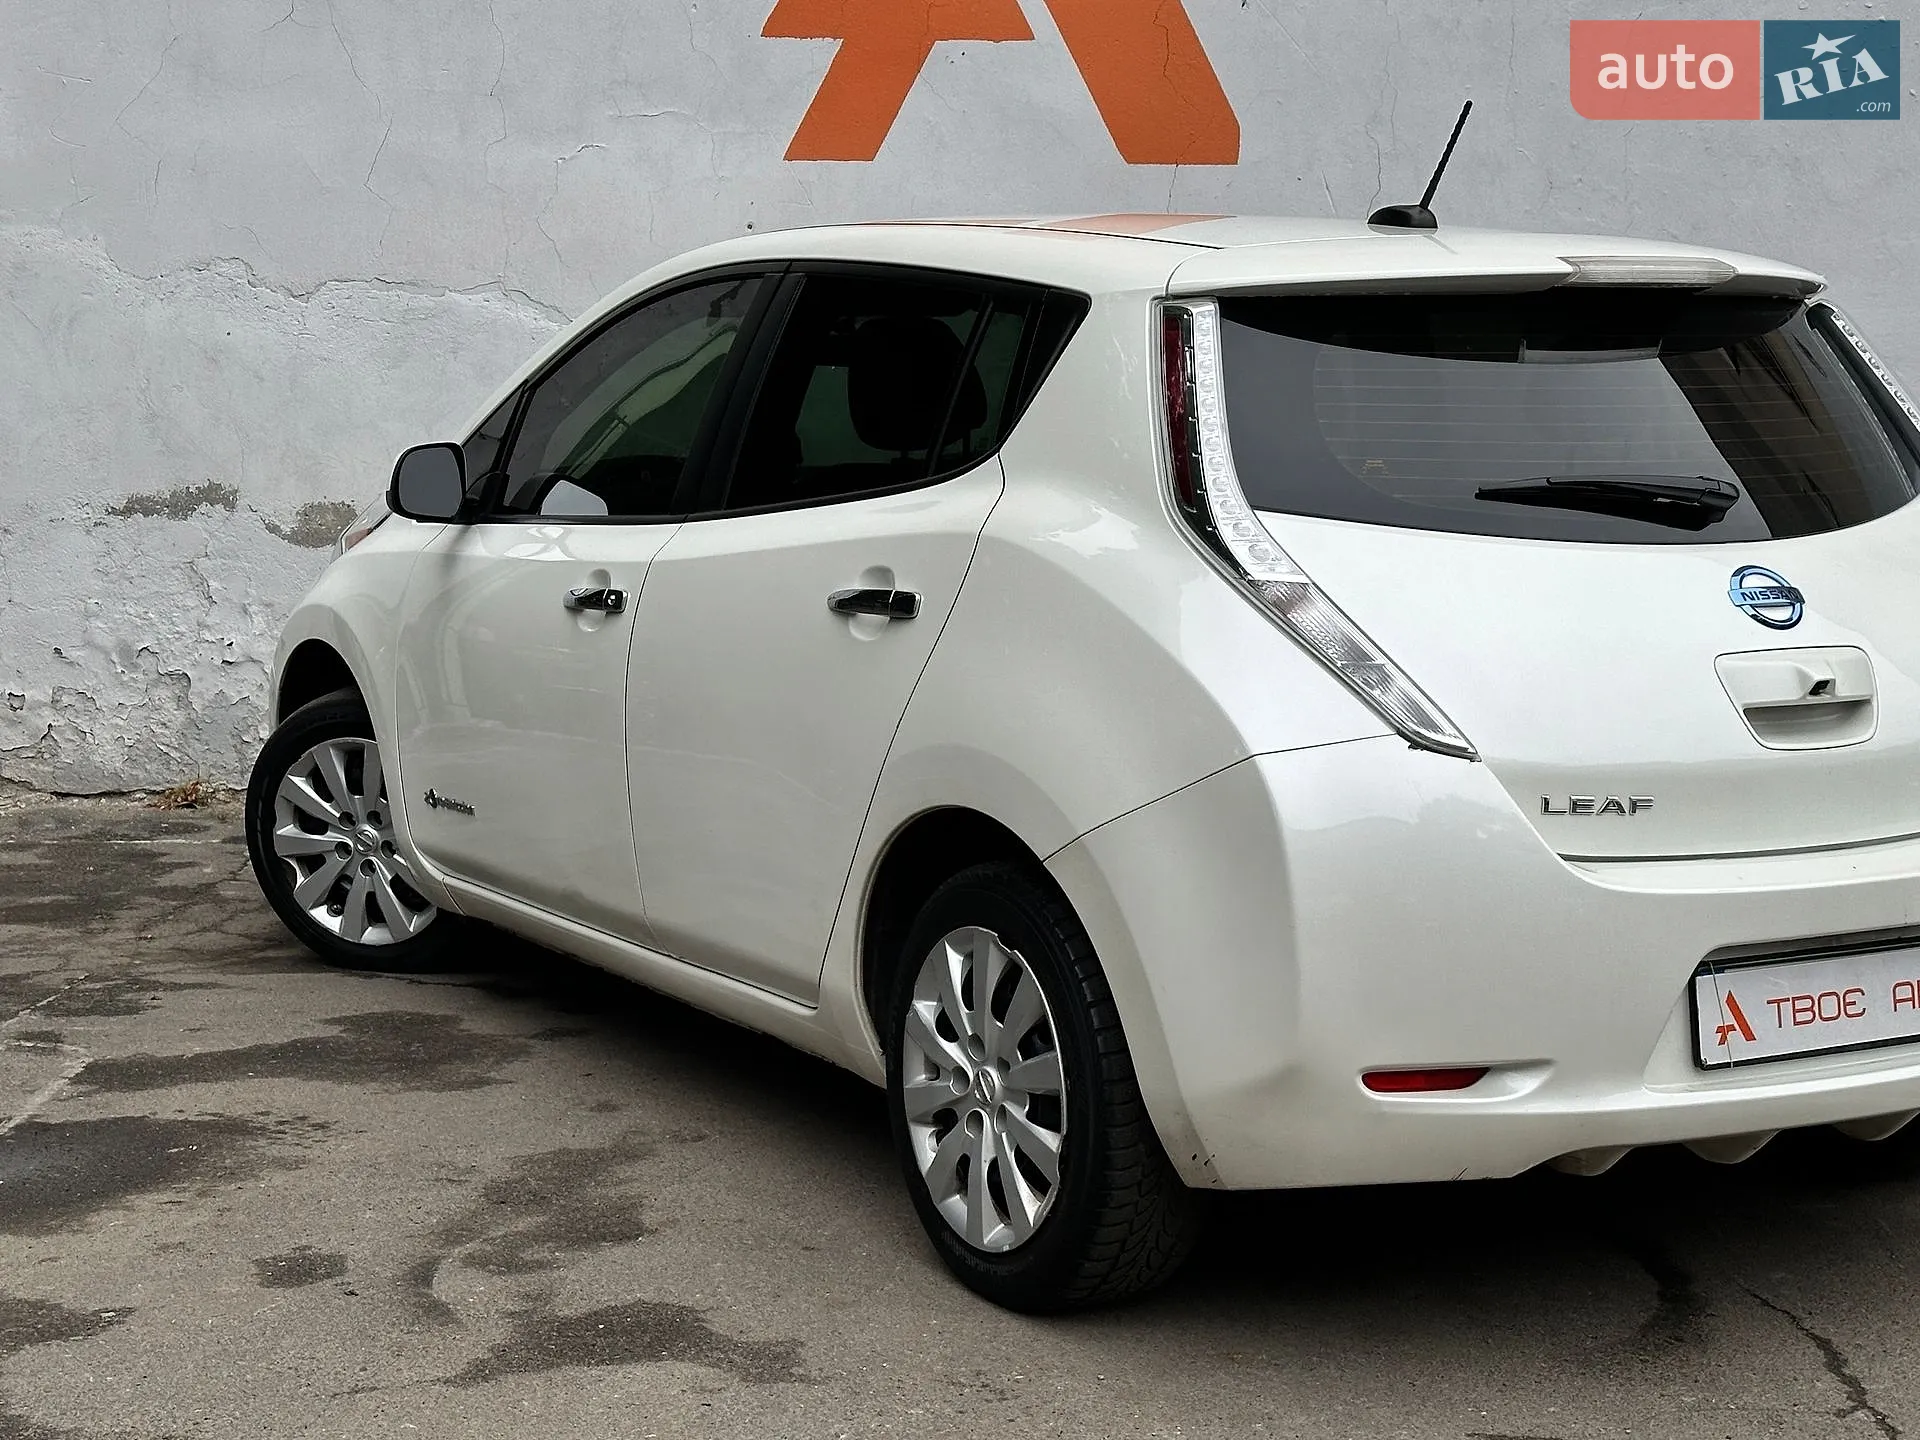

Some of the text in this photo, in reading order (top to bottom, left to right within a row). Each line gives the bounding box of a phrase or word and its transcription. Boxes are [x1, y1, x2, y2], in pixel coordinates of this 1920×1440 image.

[1740, 587, 1799, 602] NISSAN
[1540, 794, 1655, 816] LEAF
[1766, 987, 1867, 1029] ТВОЄ
[1892, 979, 1920, 1012] А
